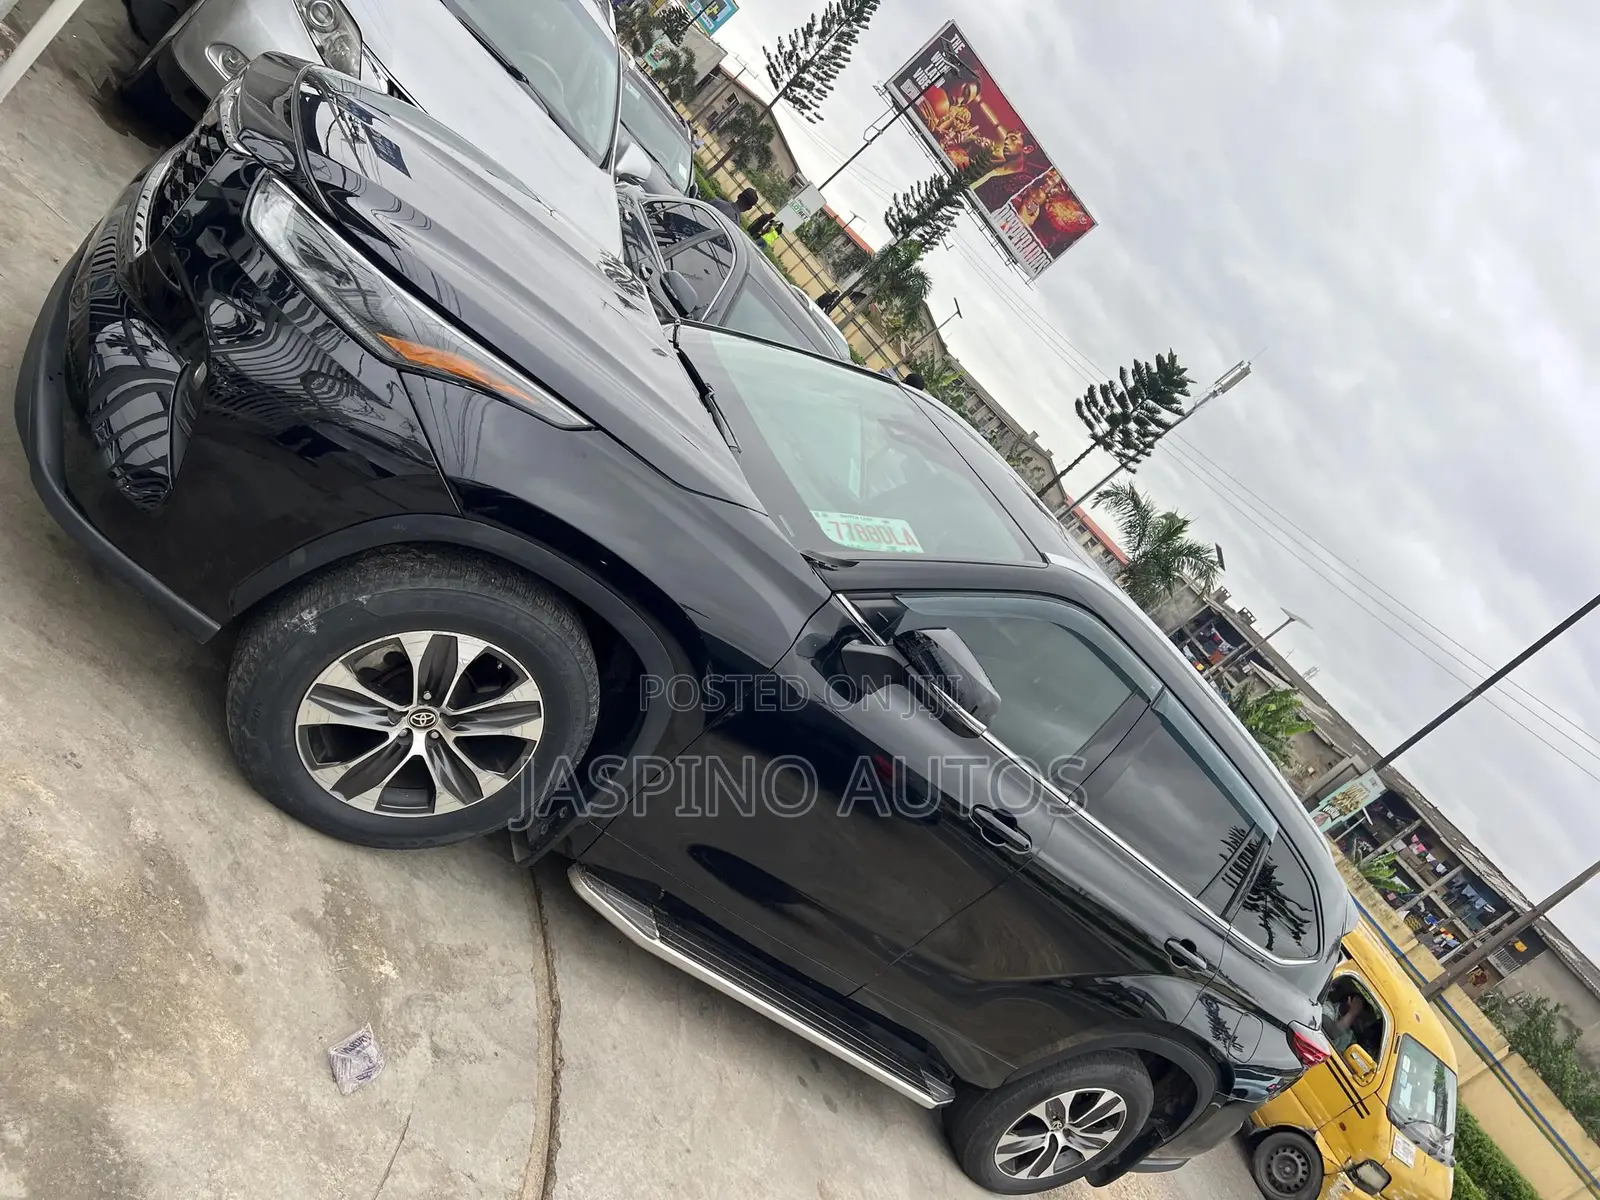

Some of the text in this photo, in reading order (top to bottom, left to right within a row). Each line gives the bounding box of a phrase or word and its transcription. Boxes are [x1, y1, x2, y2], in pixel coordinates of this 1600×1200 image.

[950, 33, 966, 54] THE
[930, 50, 953, 75] WITH
[912, 67, 933, 90] VIBE
[923, 63, 946, 89] LATN
[993, 203, 1053, 276] DESPERADOS
